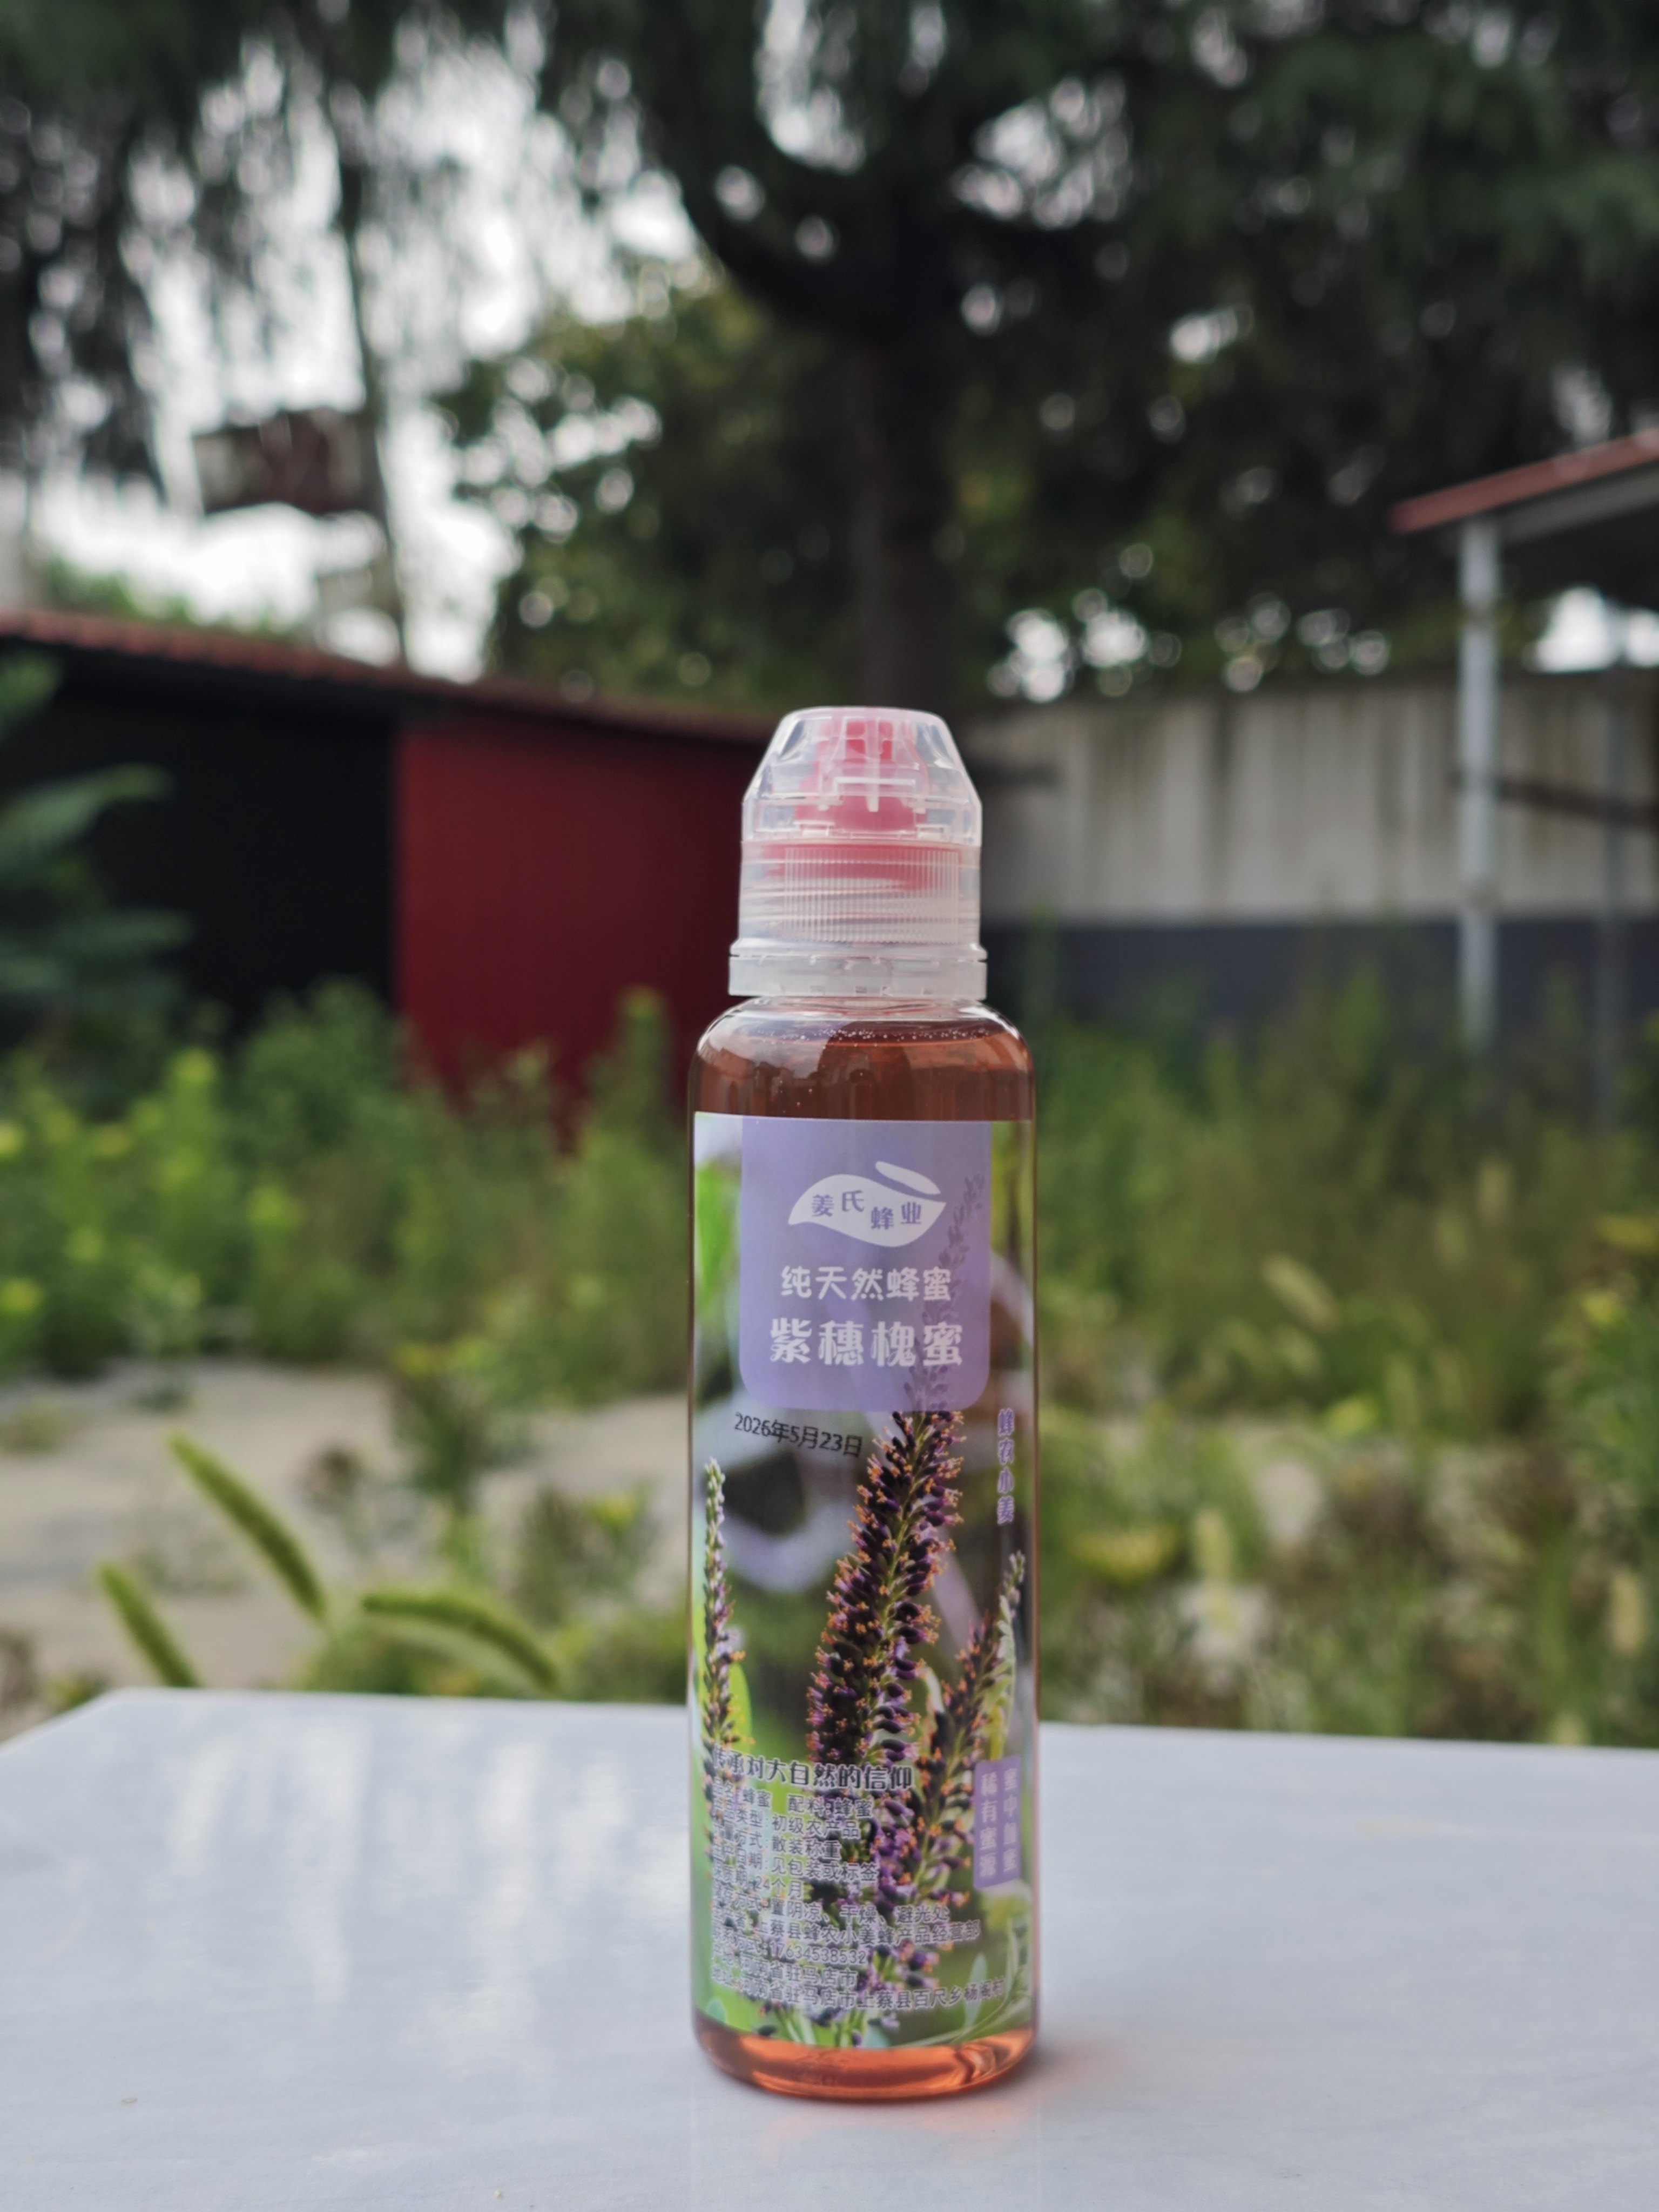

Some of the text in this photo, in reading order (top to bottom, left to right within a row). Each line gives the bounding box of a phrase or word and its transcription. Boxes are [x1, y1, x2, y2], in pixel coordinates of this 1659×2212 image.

[811, 1189, 922, 1230] 姜氏蜂业
[781, 1265, 952, 1301] 纯天然蜂蜜
[770, 1317, 963, 1367] 紫穗槐蜜
[734, 1412, 862, 1457] 2026年5月23日
[998, 1410, 1015, 1525] 蜂农小姜
[714, 1745, 912, 1790] 传承对大自然的信仰
[1003, 1768, 1017, 1872] 蜜中蜜
